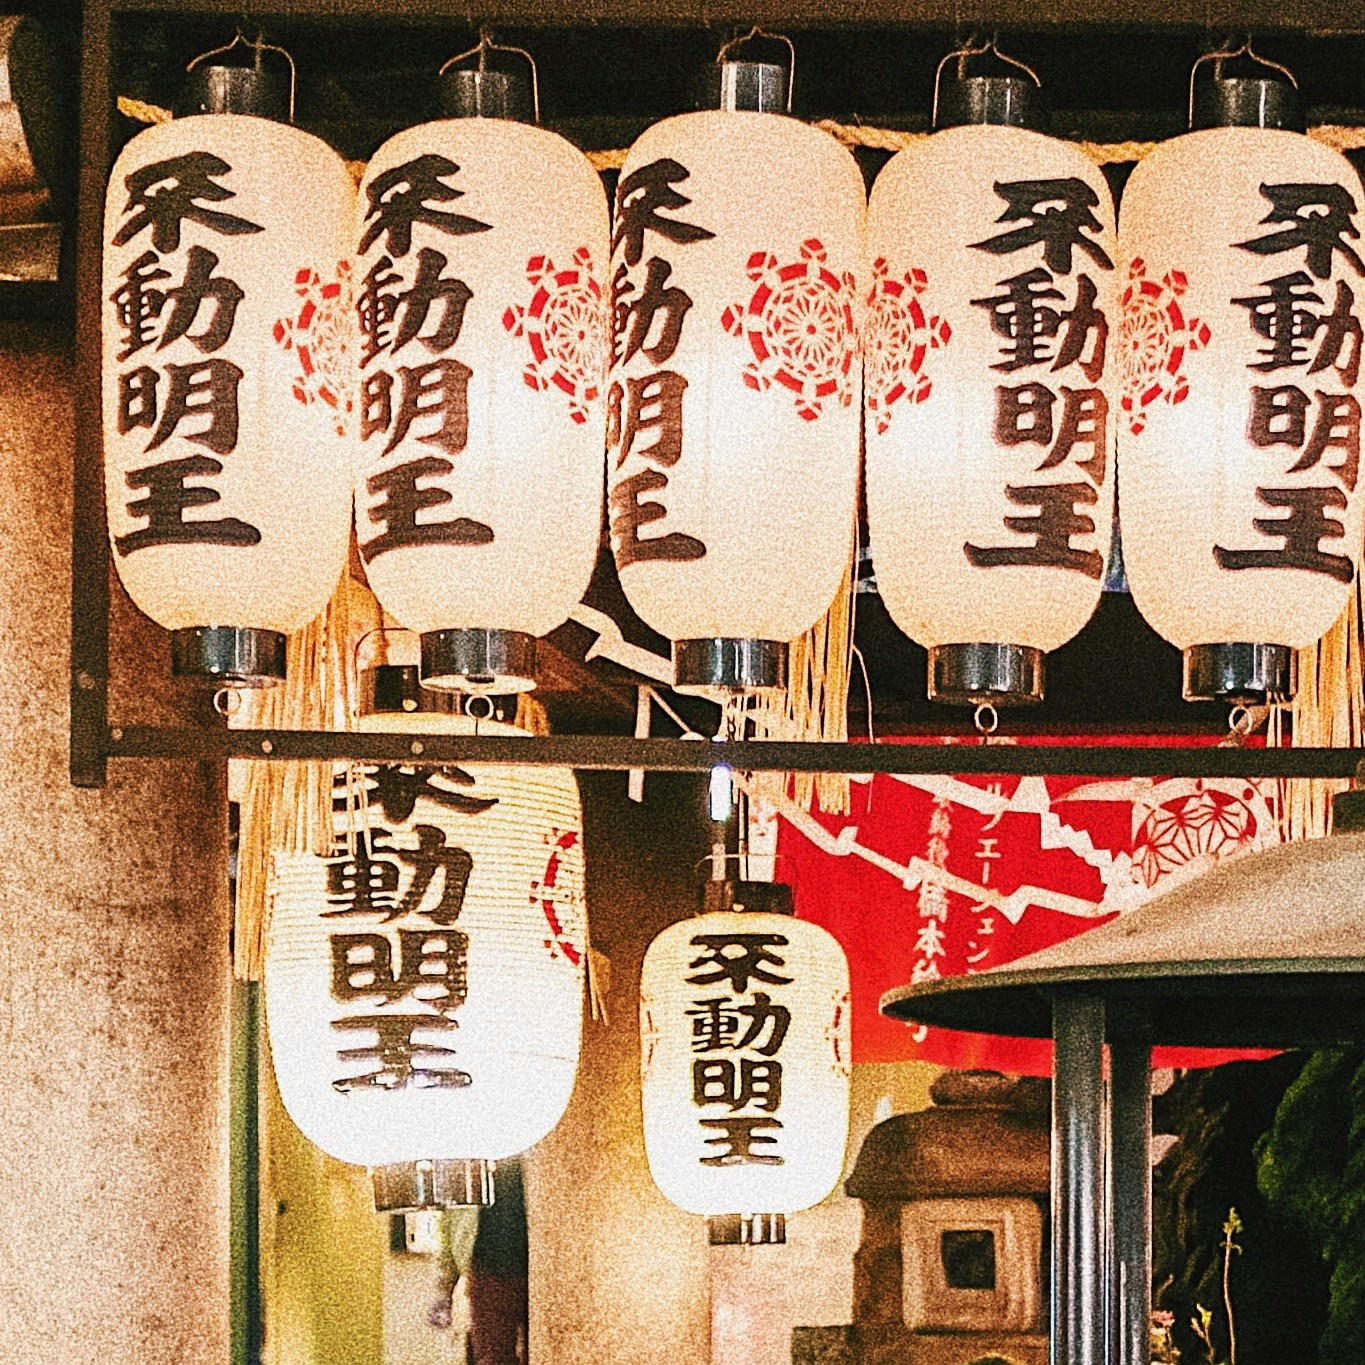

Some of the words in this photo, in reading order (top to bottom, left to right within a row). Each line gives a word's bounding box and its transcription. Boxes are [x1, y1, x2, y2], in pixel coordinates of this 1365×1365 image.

[114, 150, 266, 557] 不動明王
[358, 152, 495, 566] 不動明王
[963, 176, 1116, 581] 不動明王
[683, 933, 794, 1168] 不動明王
